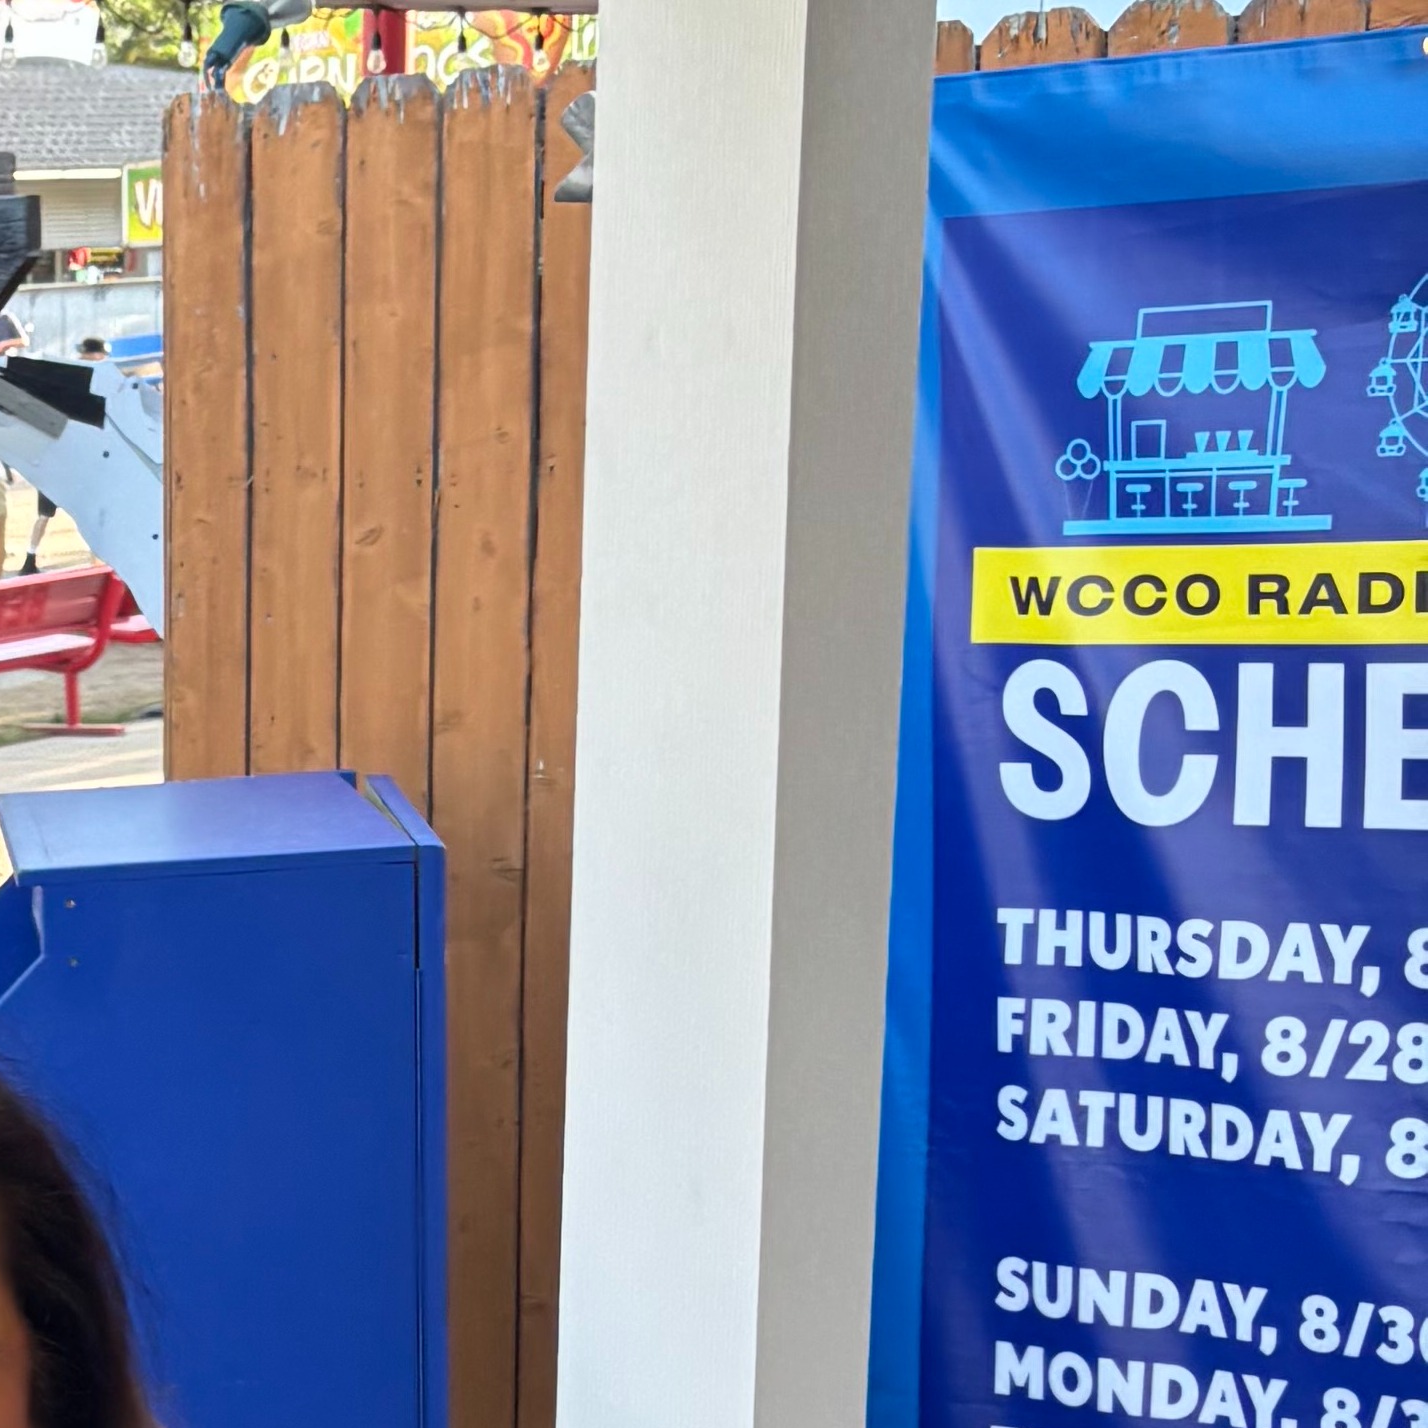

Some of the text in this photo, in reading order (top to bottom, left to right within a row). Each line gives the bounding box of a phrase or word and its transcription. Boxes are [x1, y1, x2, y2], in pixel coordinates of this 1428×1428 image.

[1010, 570, 1428, 617] WCCO RADI
[999, 659, 1428, 830] SCHE
[996, 907, 1381, 998] THURSDAY,
[996, 996, 1428, 1085] FRIDAY, 8/28
[995, 1084, 1360, 1187] SATURDAY,
[995, 1256, 1428, 1365] SUNDAY, 8/3
